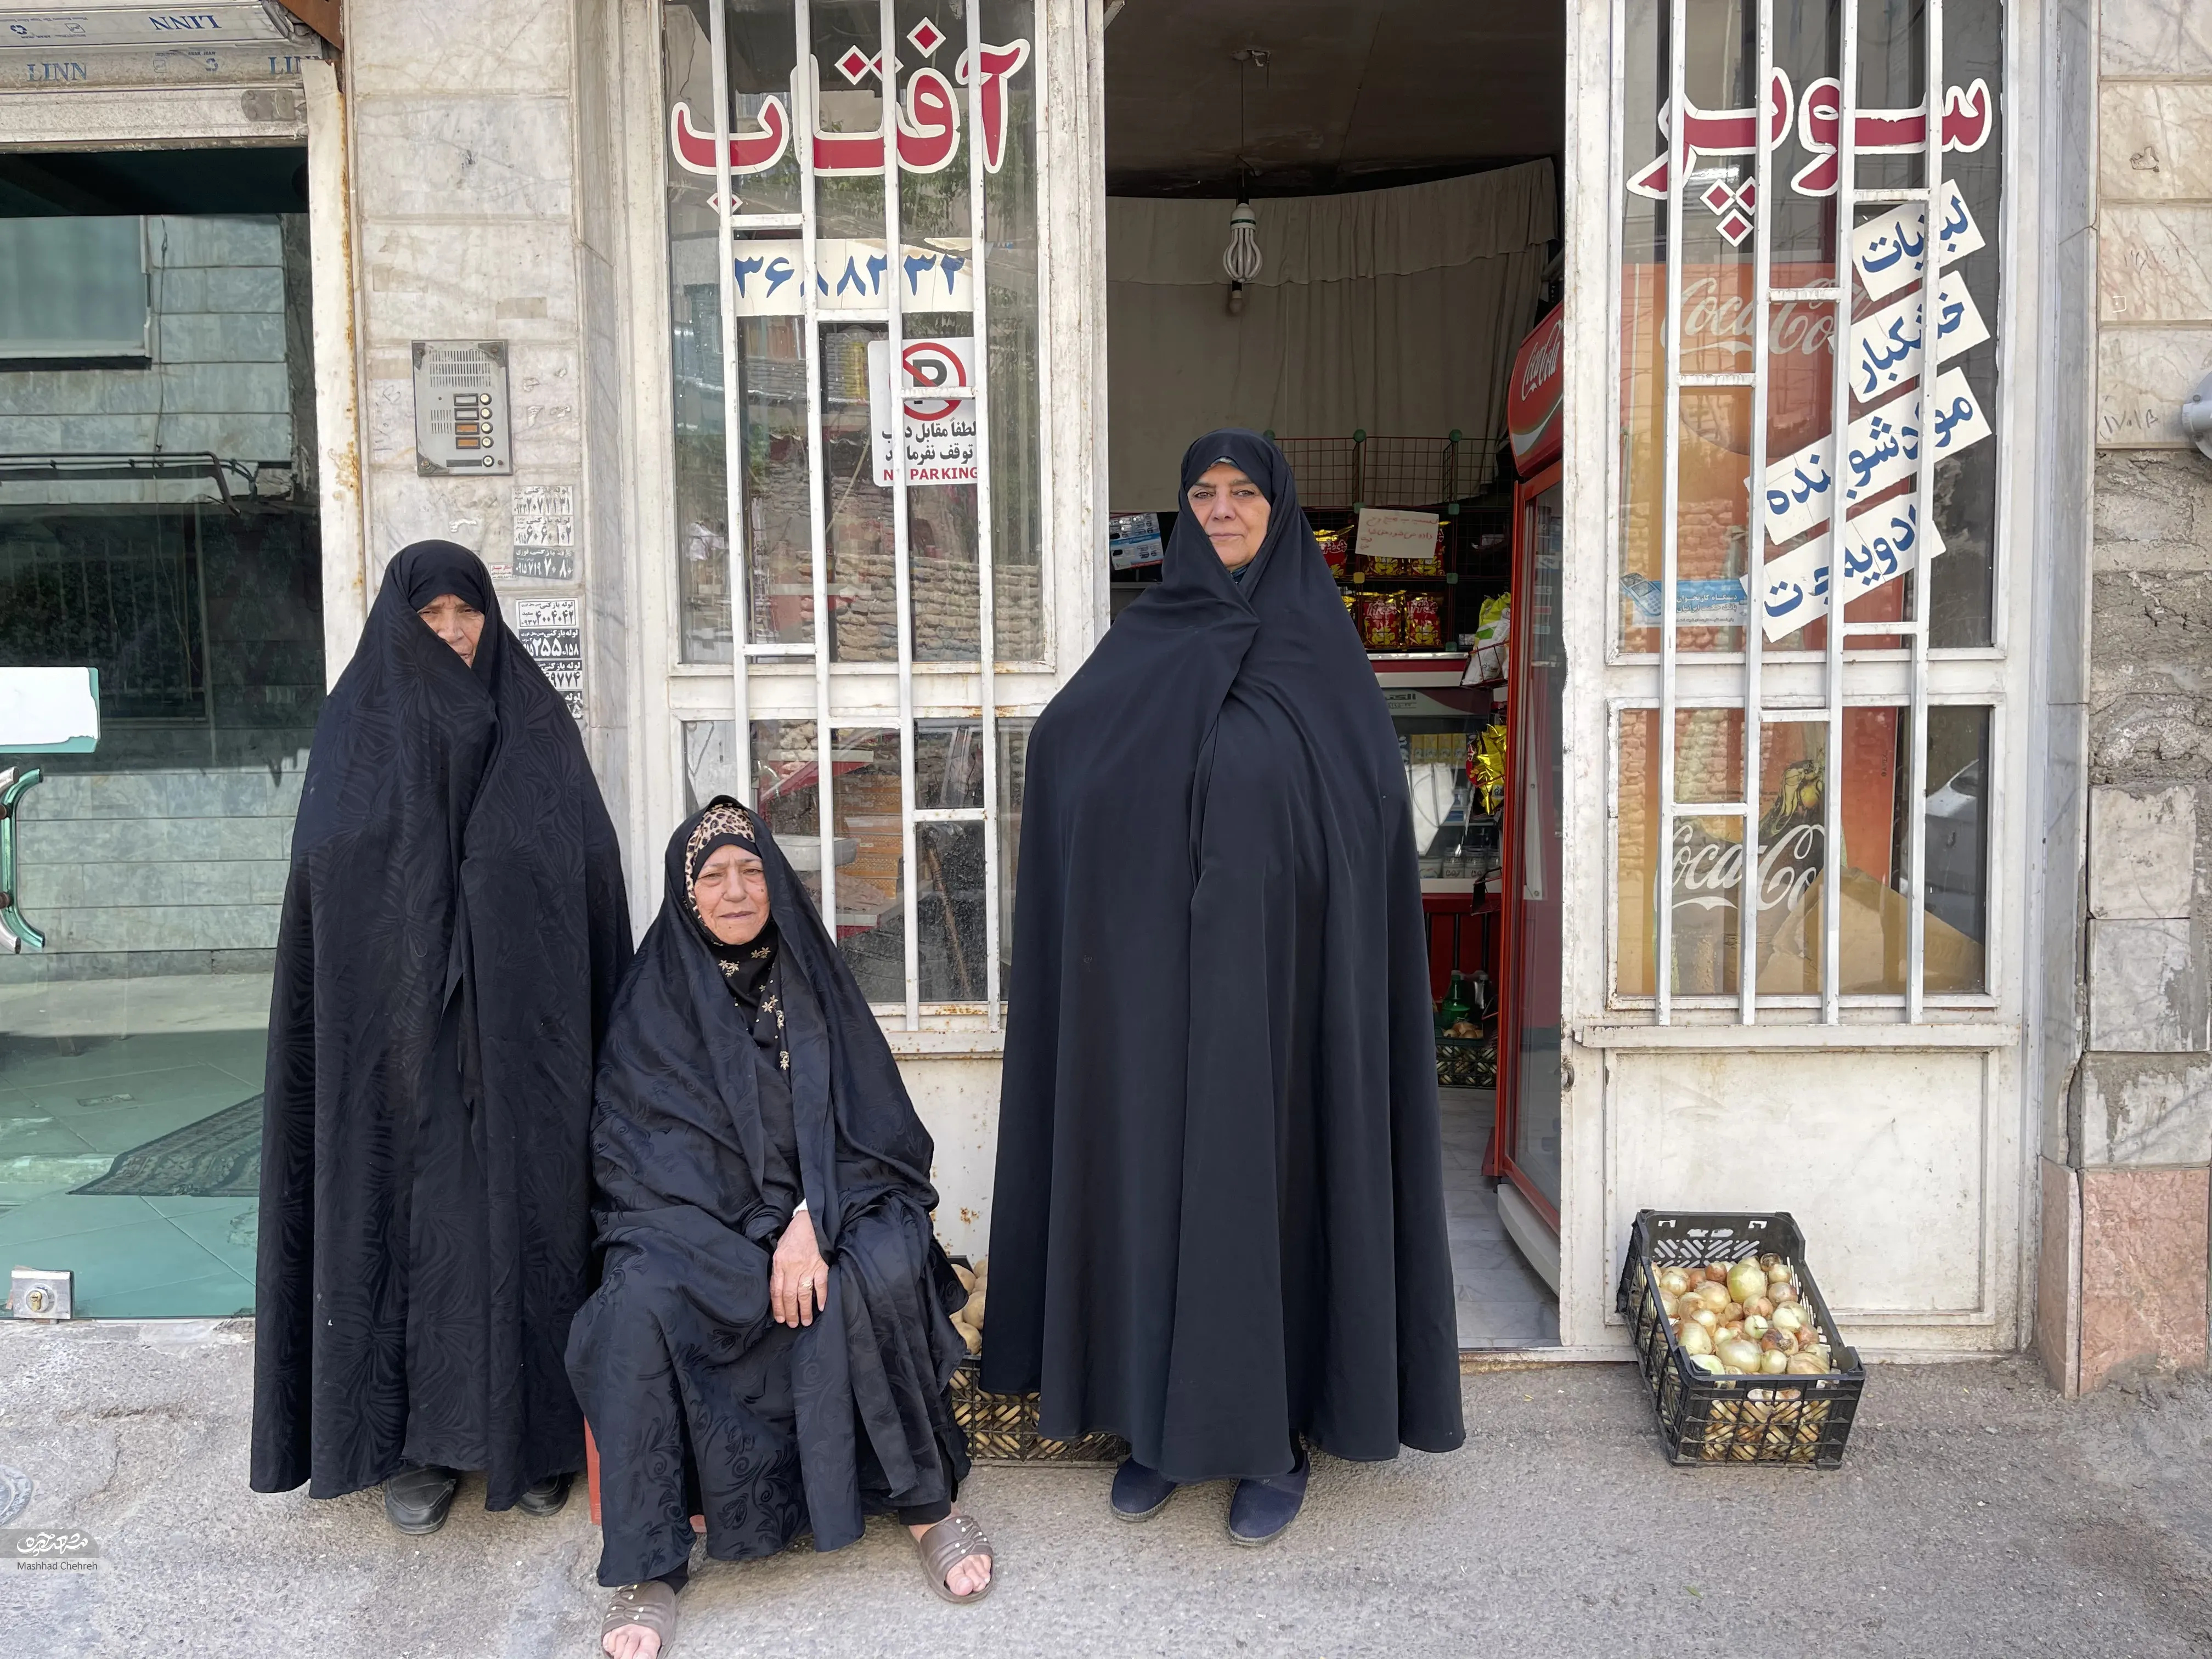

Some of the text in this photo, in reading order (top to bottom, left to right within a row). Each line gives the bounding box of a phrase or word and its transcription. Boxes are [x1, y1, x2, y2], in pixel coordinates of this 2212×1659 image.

[149, 15, 222, 30] LINN
[27, 62, 87, 82] LINN
[672, 16, 1991, 247] سوپر آفتاب
[1861, 292, 1965, 394] خکبار
[882, 426, 912, 443] دب
[916, 422, 948, 443] مقابل
[885, 443, 973, 465] توقف نفرماد
[911, 467, 977, 480] PARKING
[1767, 416, 1899, 515] شونده
[566, 629, 578, 637] لوله
[567, 662, 580, 670] لوله
[545, 671, 581, 687] ۹۷۷۴
[565, 692, 581, 703] لوله
